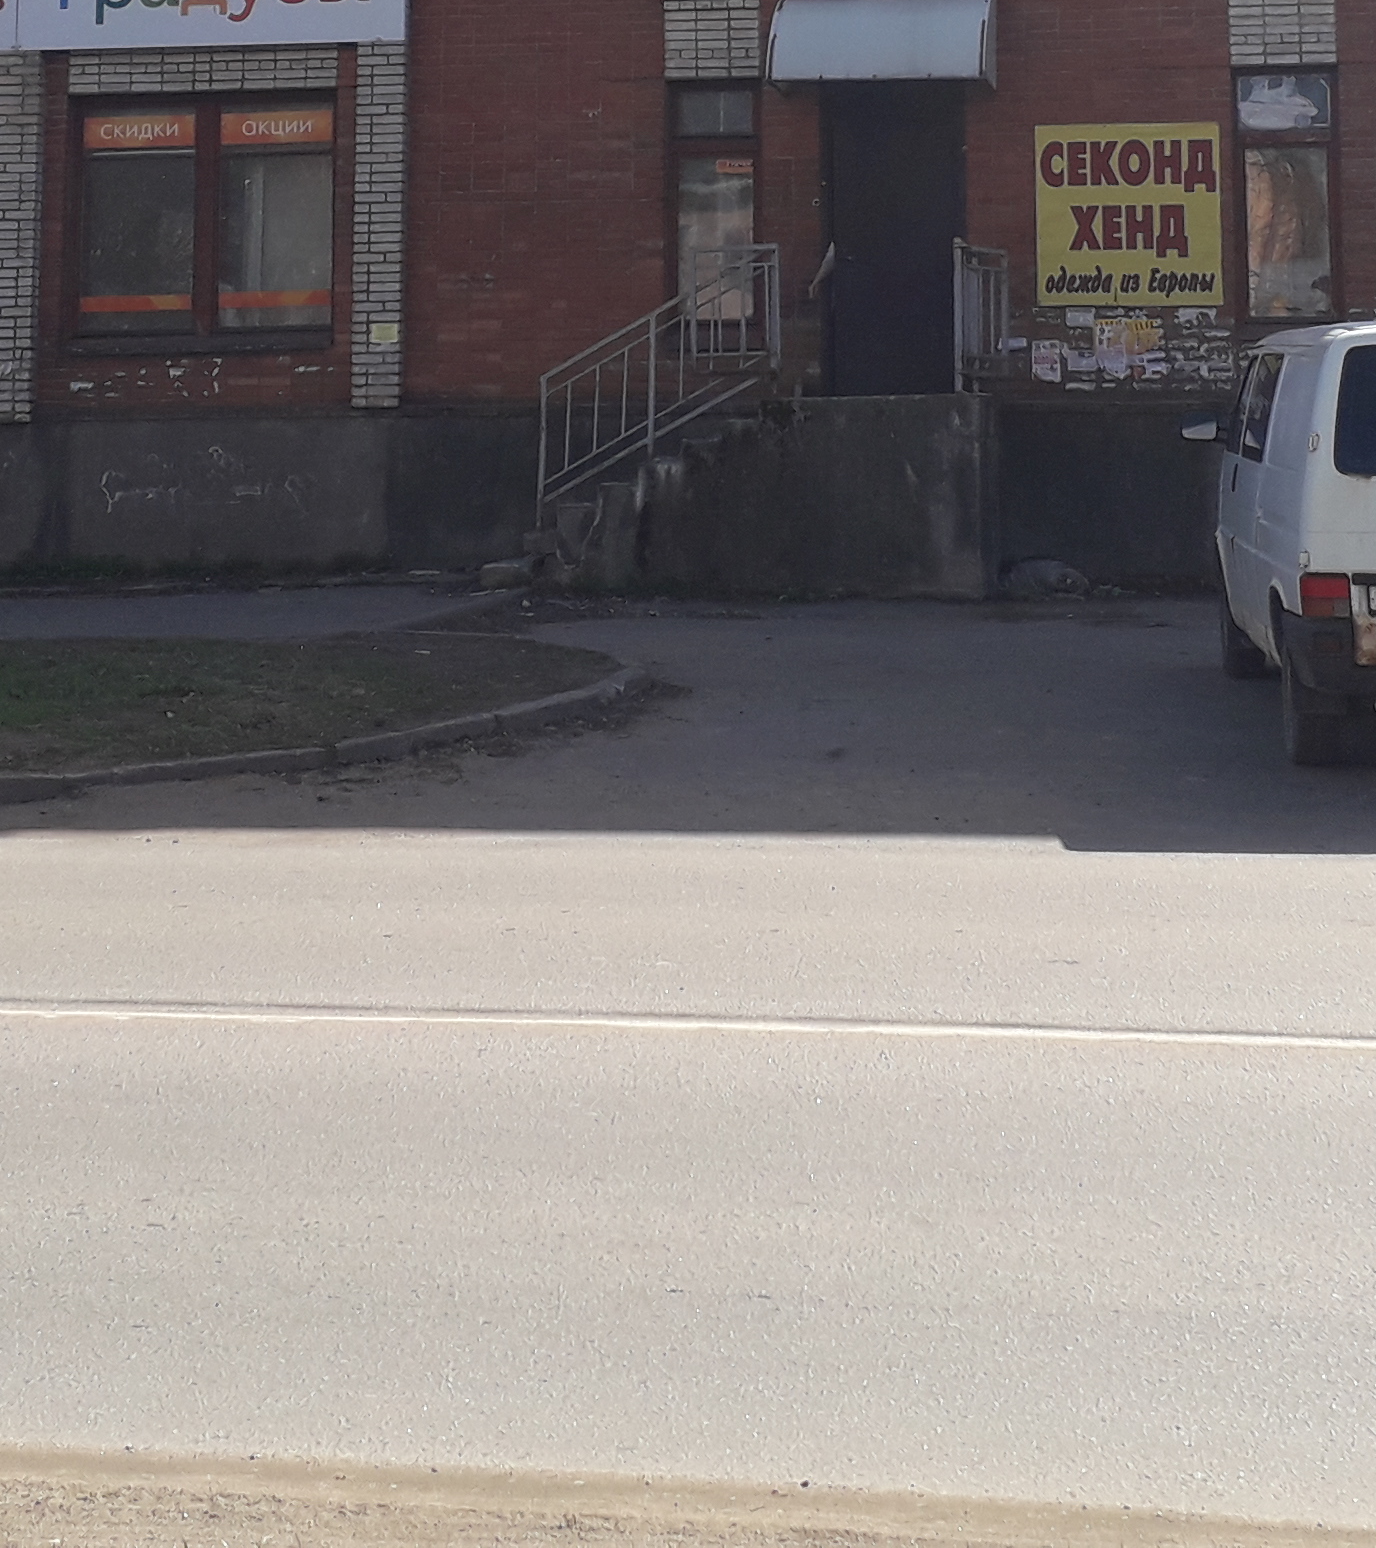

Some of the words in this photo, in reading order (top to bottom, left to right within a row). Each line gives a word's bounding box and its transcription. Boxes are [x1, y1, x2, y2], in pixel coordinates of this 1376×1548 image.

[99, 120, 179, 141] скидки
[241, 117, 313, 139] акции
[1039, 139, 1217, 193] СЕКОНД
[1068, 203, 1190, 259] ХЕНД
[1045, 265, 1113, 295] одежда
[1119, 271, 1140, 294] из
[1147, 268, 1216, 298] Европы
